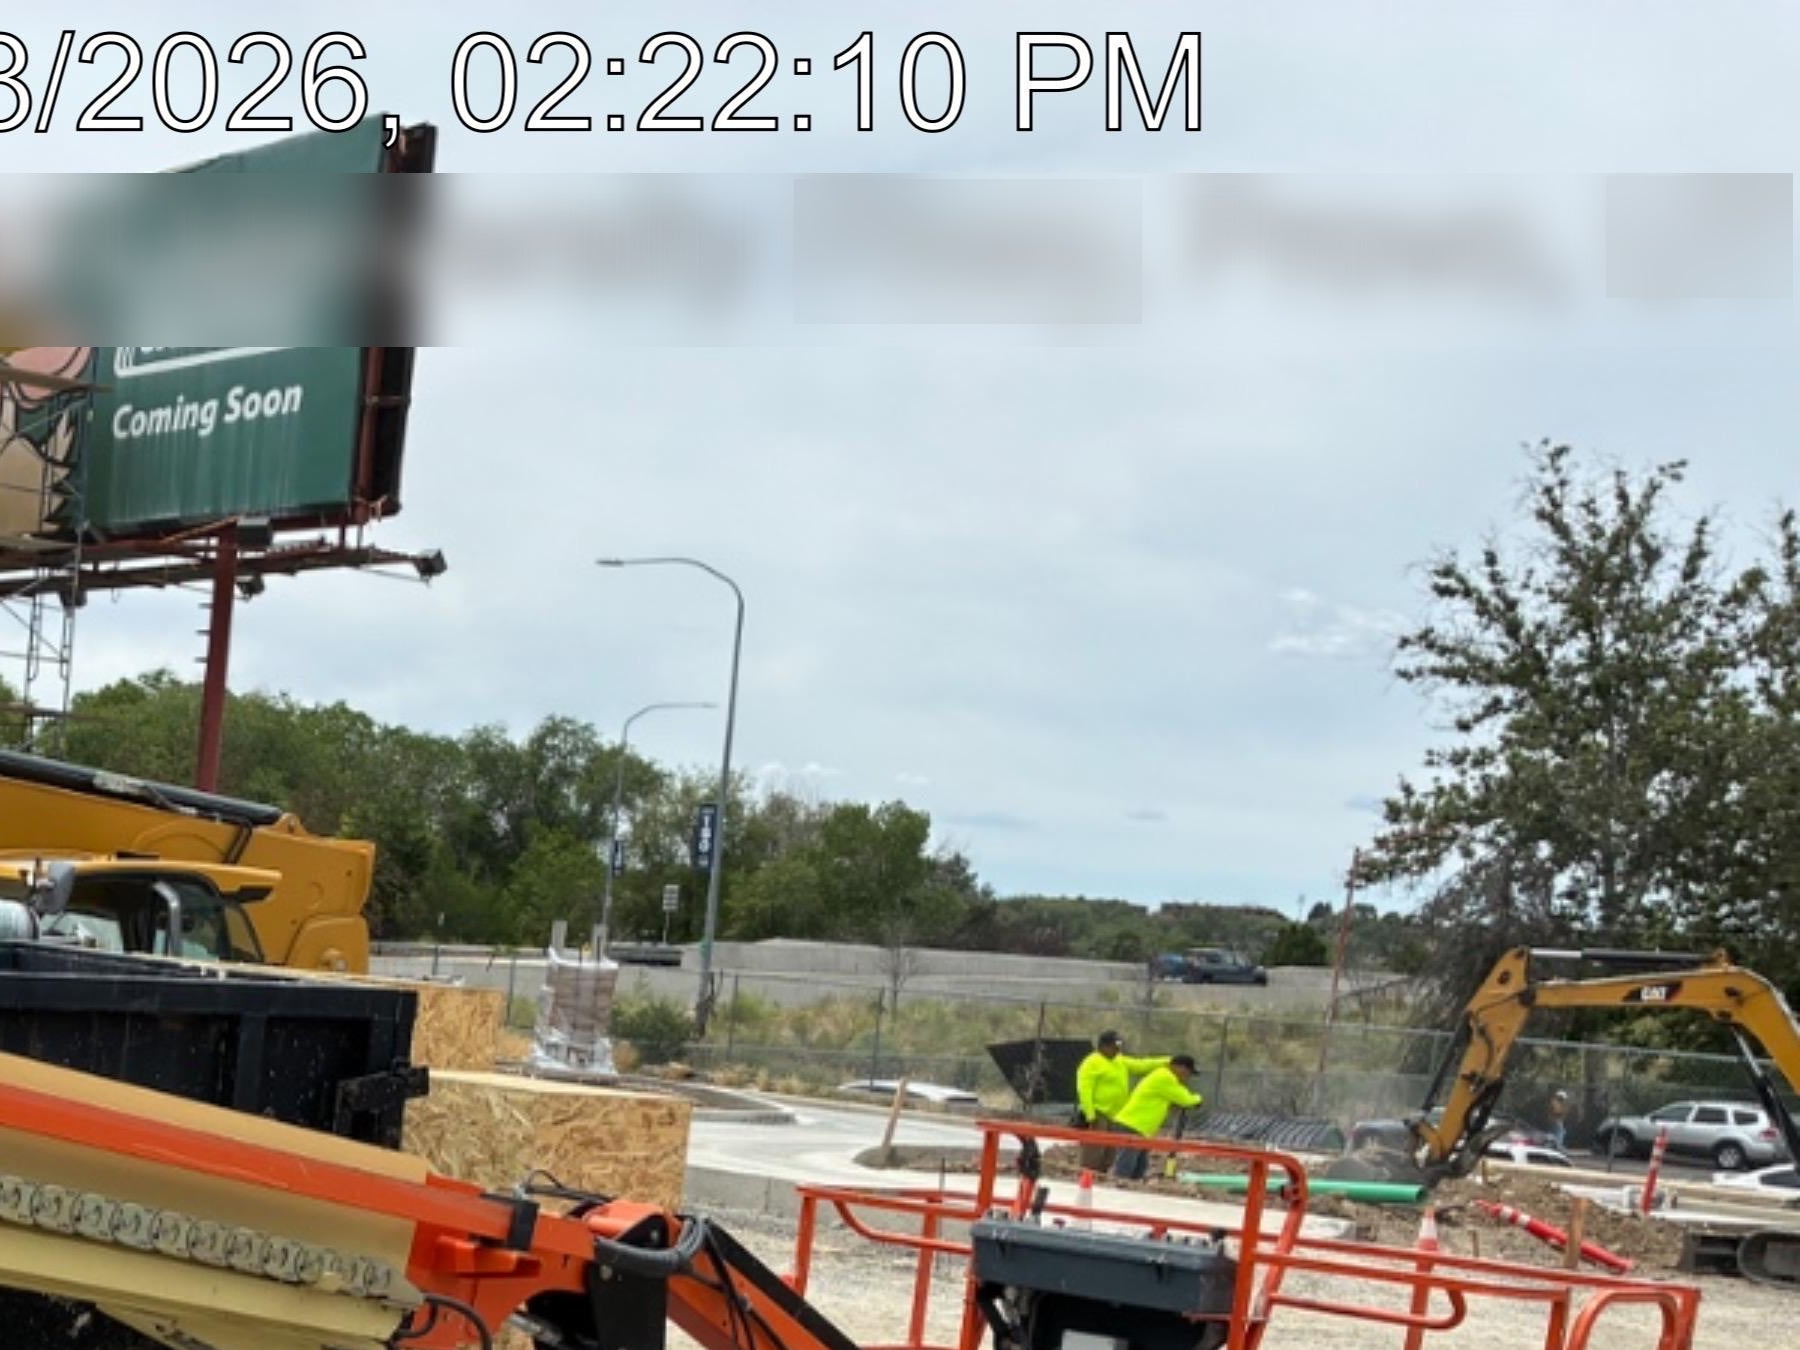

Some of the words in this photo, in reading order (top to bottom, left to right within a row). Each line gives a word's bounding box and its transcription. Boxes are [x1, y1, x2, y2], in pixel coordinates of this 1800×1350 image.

[112, 394, 219, 439] Coming
[223, 383, 304, 424] Soon
[1640, 985, 1667, 1001] CAT
